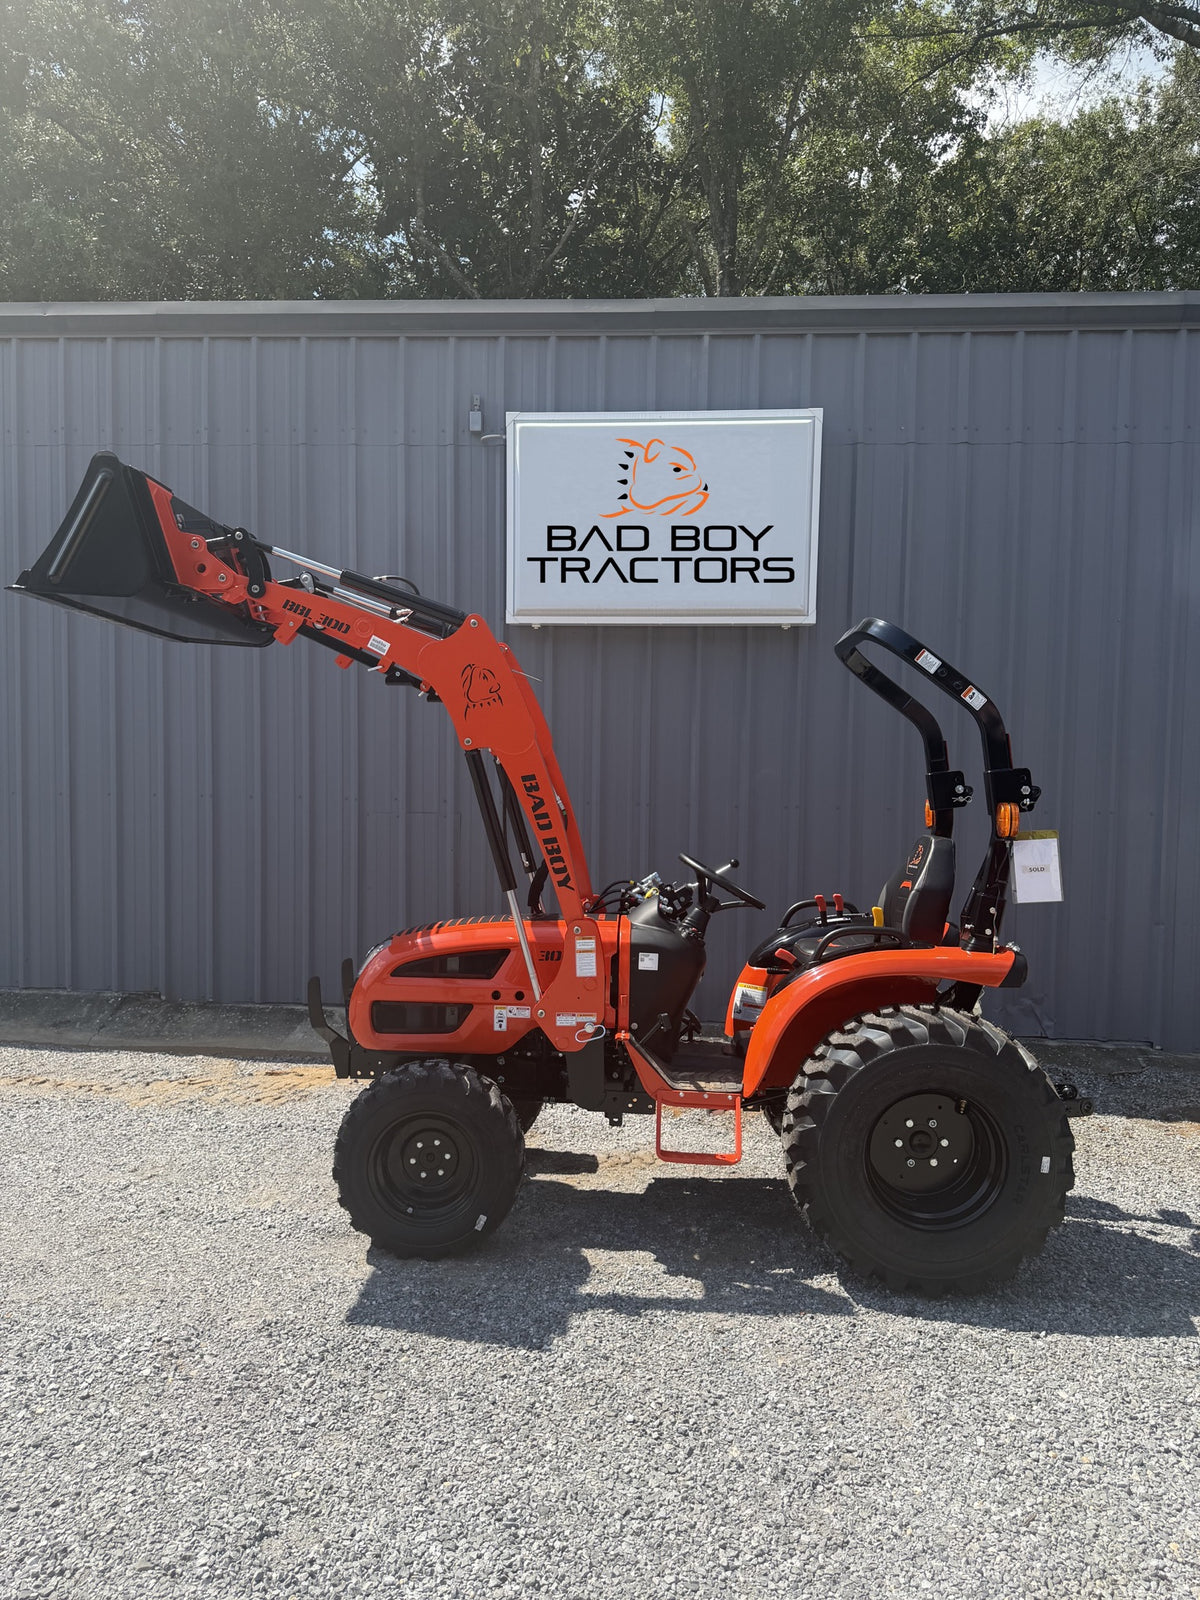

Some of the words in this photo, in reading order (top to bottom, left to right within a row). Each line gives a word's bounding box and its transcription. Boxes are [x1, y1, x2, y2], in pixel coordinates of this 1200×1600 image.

[547, 525, 650, 552] BAD
[671, 525, 774, 552] BOY
[527, 557, 795, 583] TRACTORS
[282, 599, 312, 620] BBL
[316, 613, 351, 634] 300
[521, 774, 552, 831] BAD
[542, 837, 575, 891] BOY
[538, 950, 562, 961] 30
[1012, 1124, 1031, 1205] CARLSTAR
